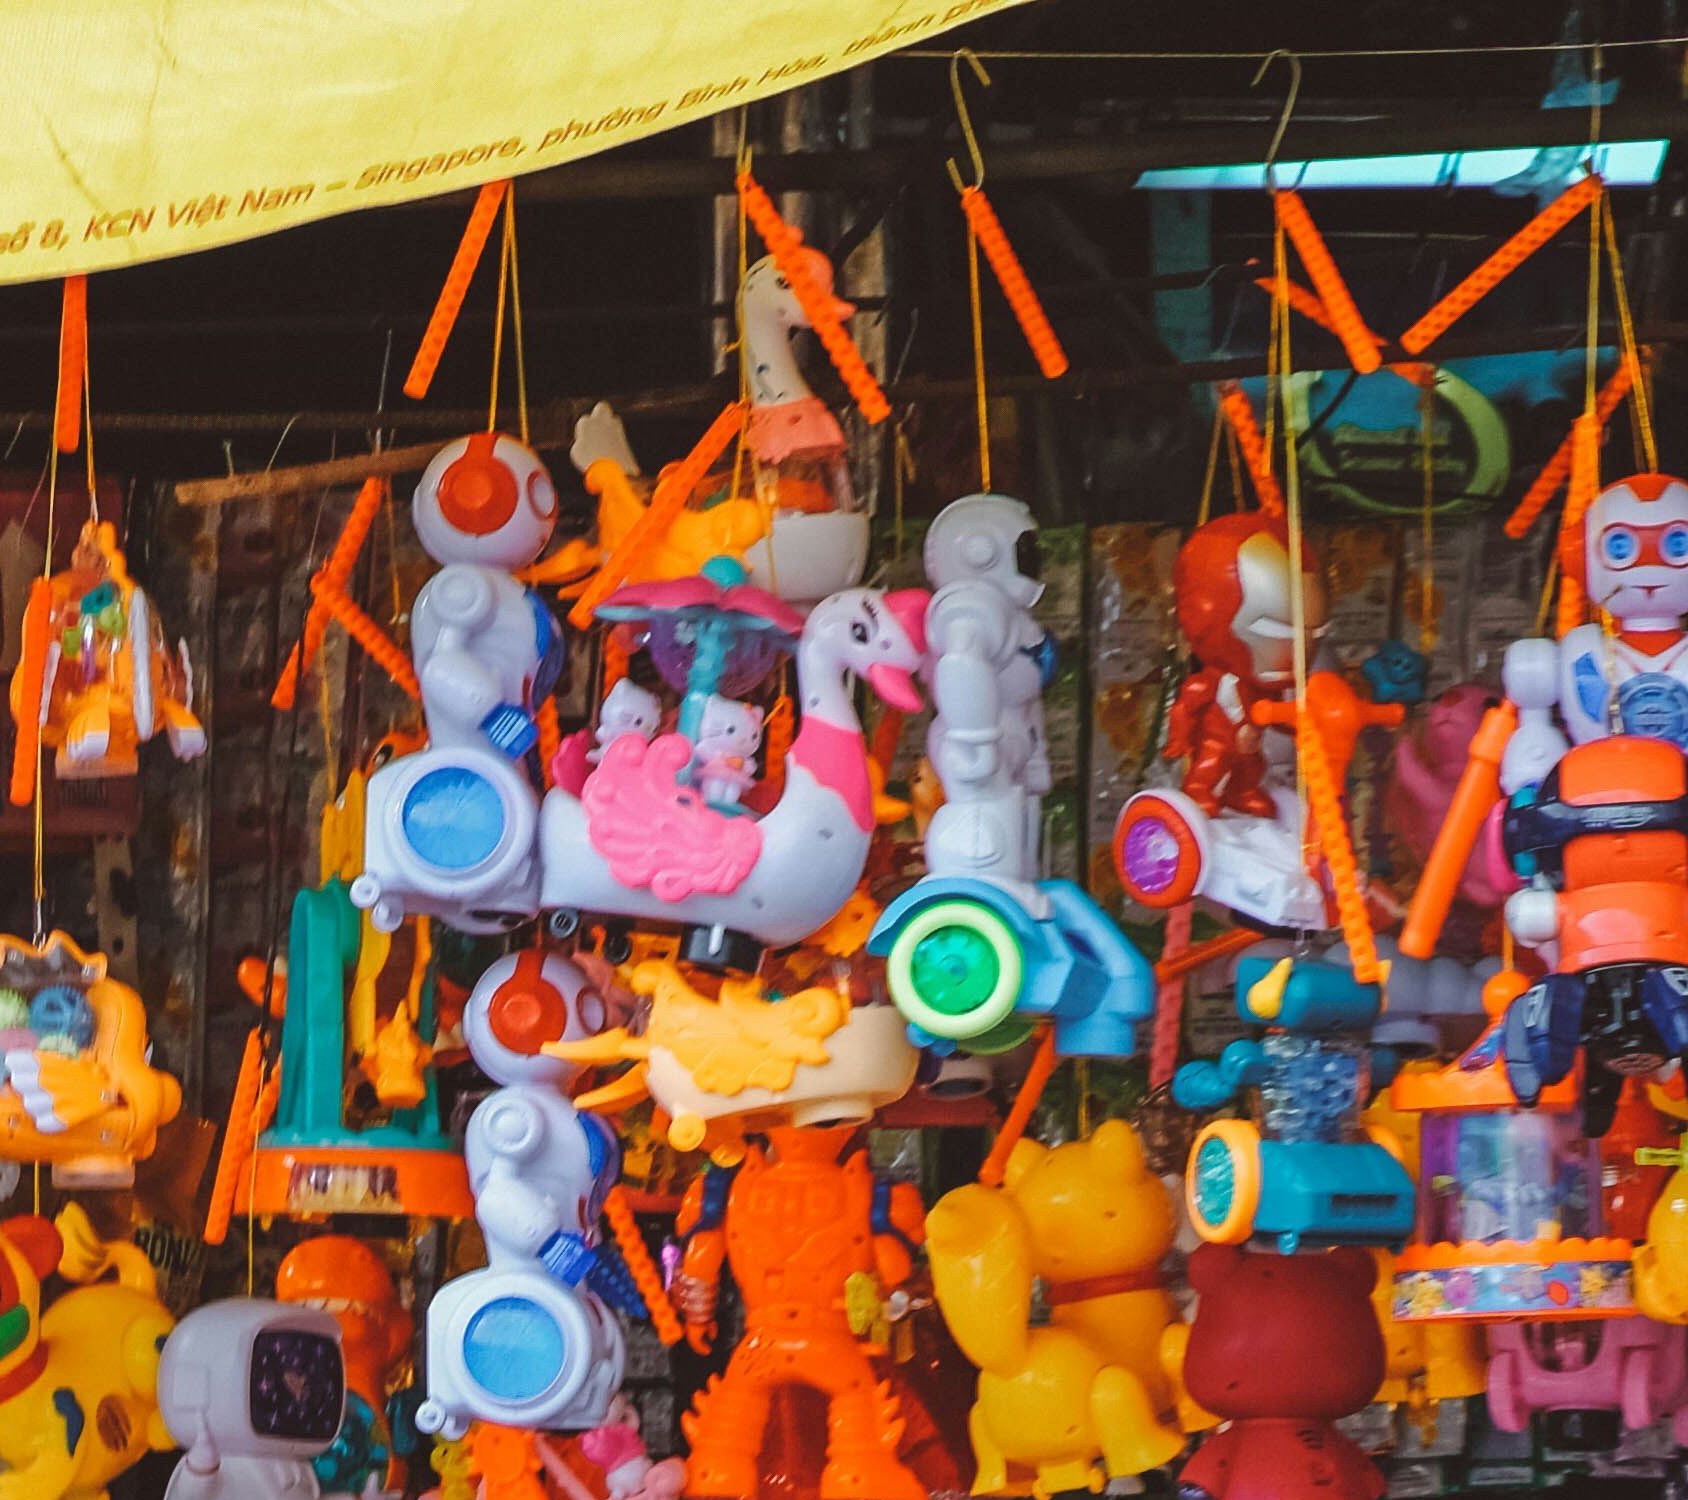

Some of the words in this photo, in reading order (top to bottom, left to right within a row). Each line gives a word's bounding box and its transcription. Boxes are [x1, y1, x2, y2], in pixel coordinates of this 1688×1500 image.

[83, 206, 154, 242] KCN
[167, 195, 228, 231] Việt
[236, 179, 314, 220] Nam
[357, 132, 529, 191] Singapore,
[535, 98, 669, 154] phường
